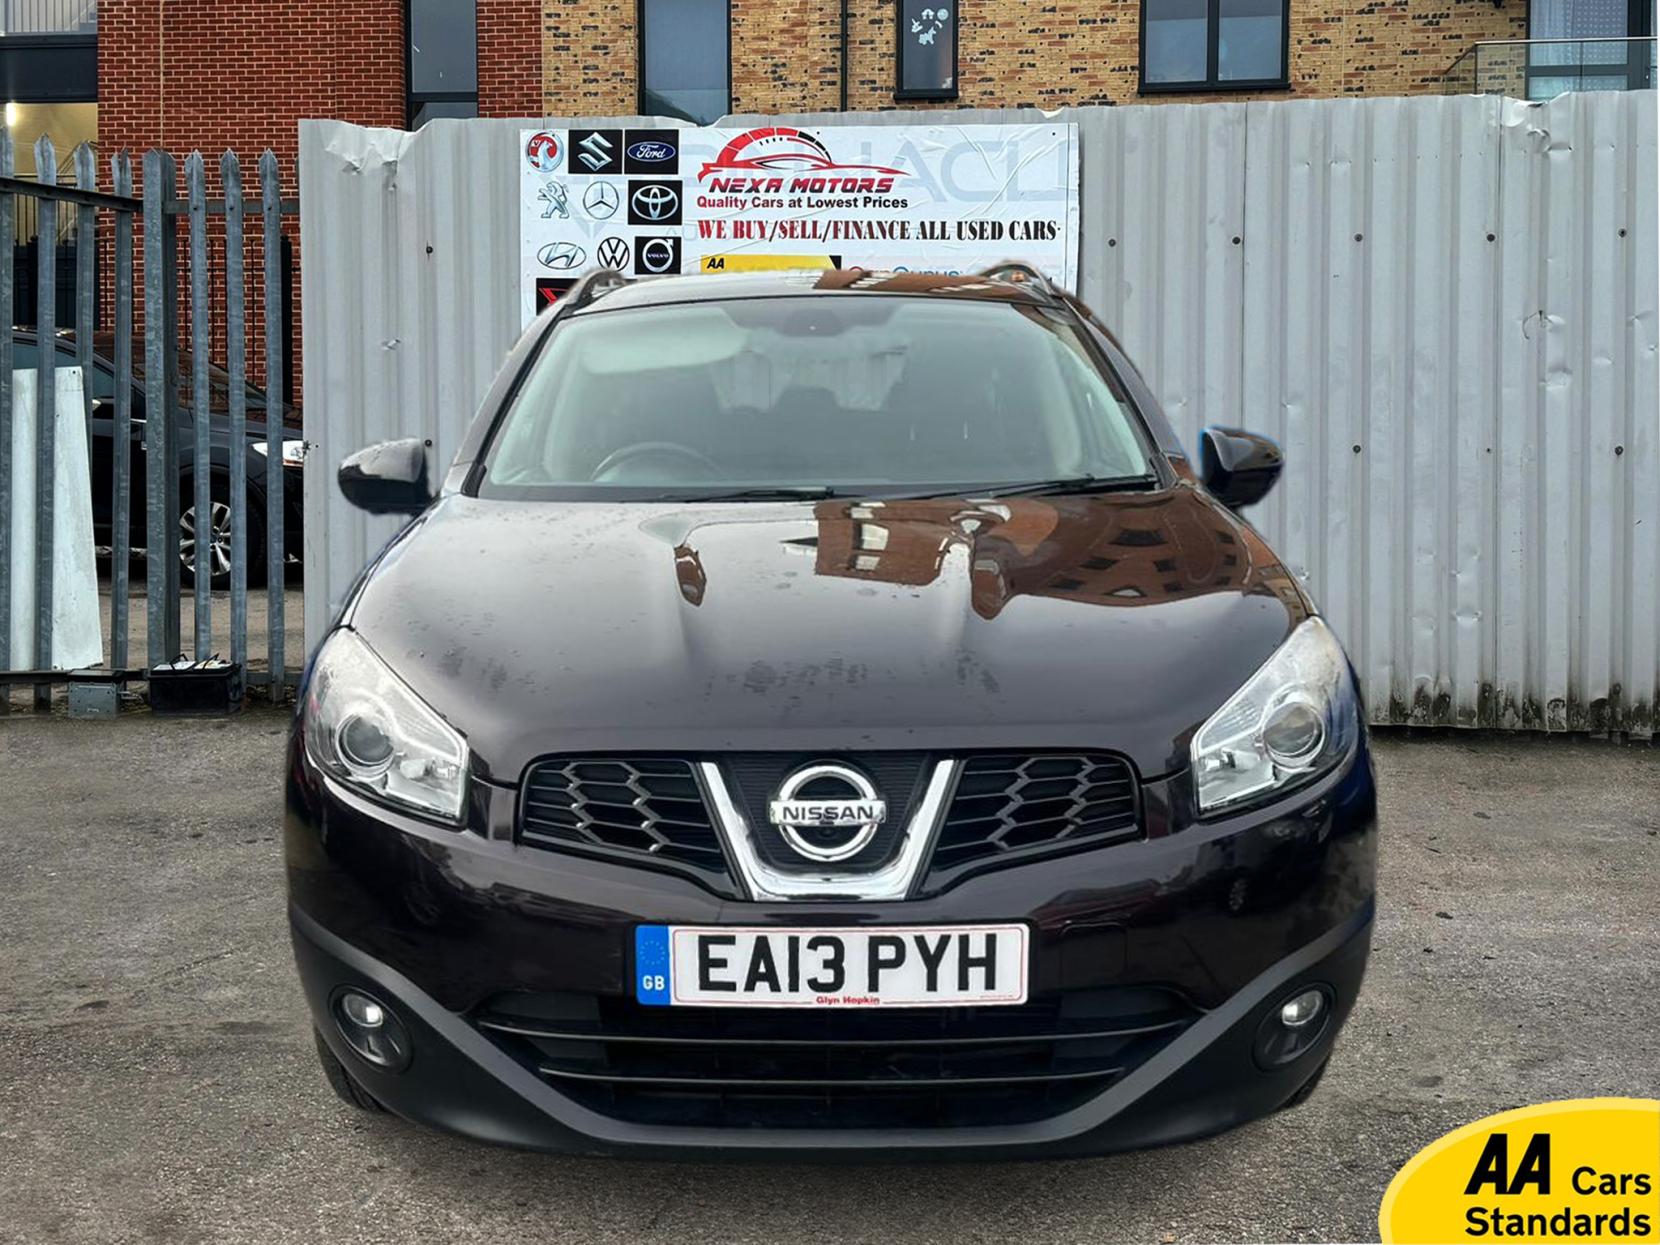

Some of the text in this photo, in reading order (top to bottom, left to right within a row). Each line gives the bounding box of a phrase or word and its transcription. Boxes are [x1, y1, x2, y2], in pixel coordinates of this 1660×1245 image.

[636, 144, 666, 158] Ford
[709, 178, 894, 193] NEXA MOTORS
[697, 196, 908, 210] Quality Cars at Lowest Prices
[697, 220, 727, 239] WE
[916, 221, 951, 240] ALL
[956, 221, 1004, 240] USED
[706, 257, 725, 269] AA
[782, 805, 874, 823] NISSAN
[698, 932, 998, 993] EA13 PYH
[642, 976, 665, 991] GB
[816, 995, 880, 1005] Glyn Hopkin
